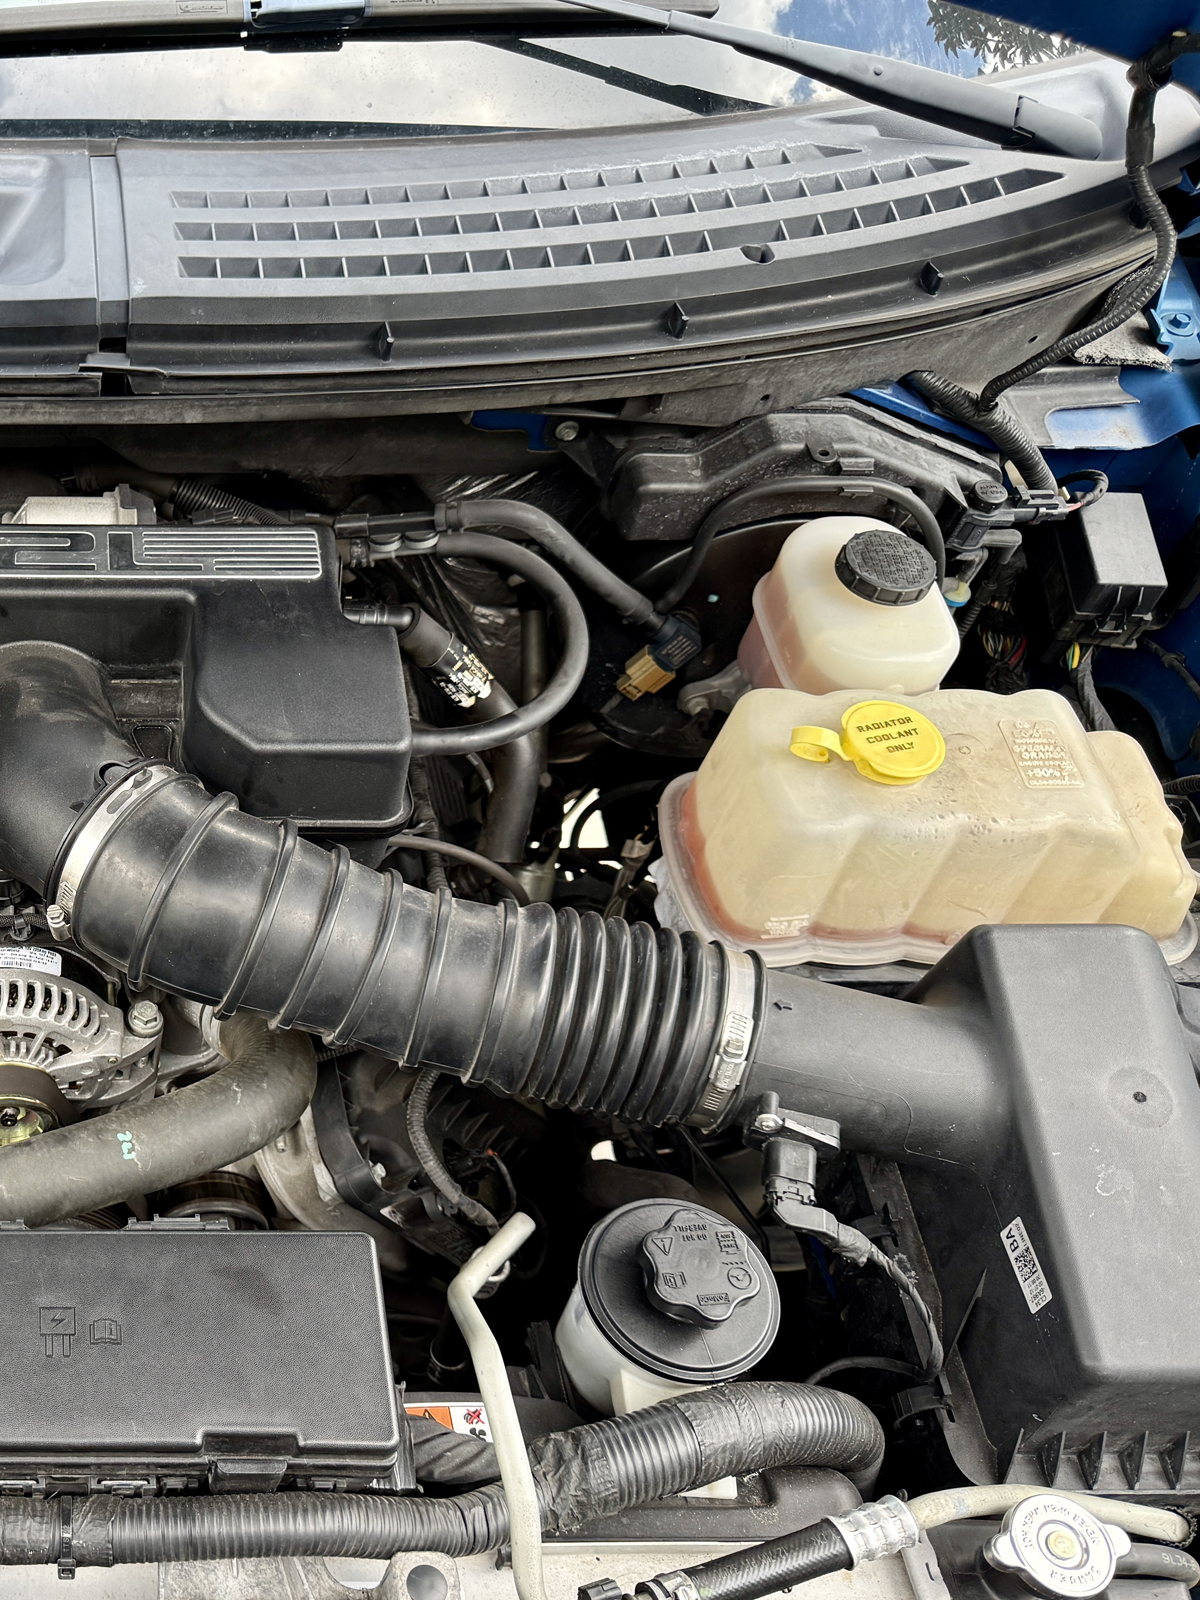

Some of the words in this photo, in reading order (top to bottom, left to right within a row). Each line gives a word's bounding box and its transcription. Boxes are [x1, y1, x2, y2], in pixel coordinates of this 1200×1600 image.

[856, 716, 914, 733] RADIATOR
[866, 728, 920, 744] COOLANT
[886, 741, 915, 754] ONLY
[672, 1223, 708, 1233] OVERFILL
[682, 1234, 696, 1242] NOT
[697, 1233, 708, 1241] DO
[1005, 1227, 1020, 1253] BA
[699, 1293, 730, 1304] FoMoCo
[1073, 1513, 1100, 1546] NEVER
[1049, 1568, 1101, 1586] DANGER
